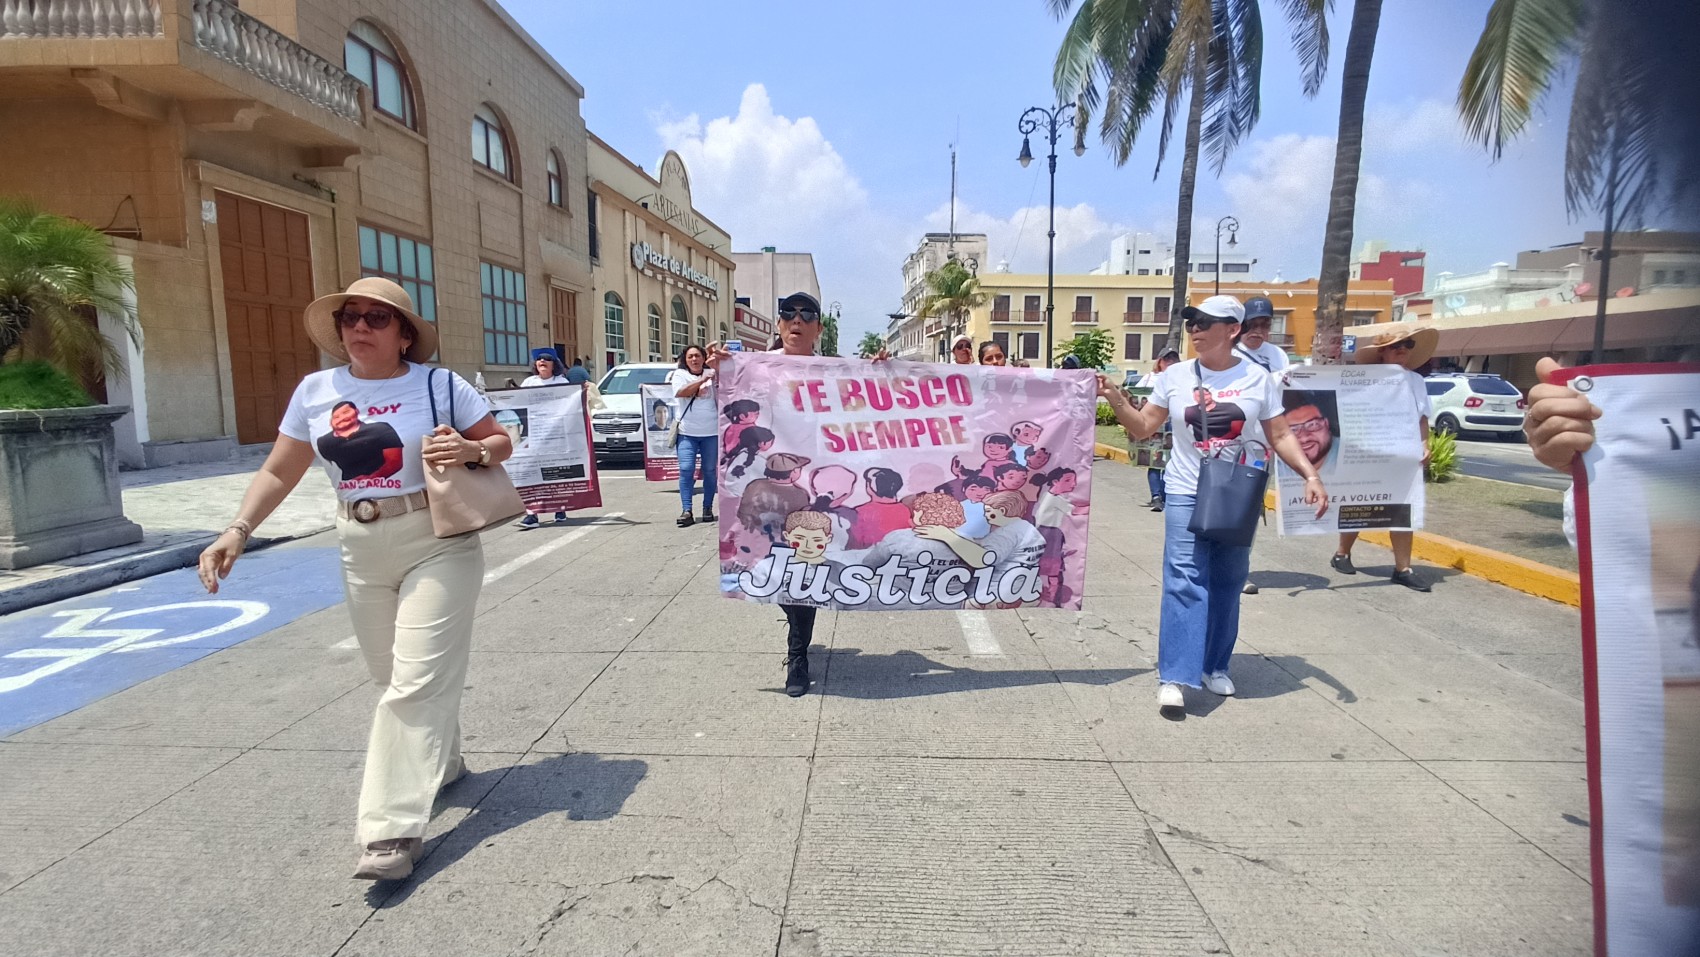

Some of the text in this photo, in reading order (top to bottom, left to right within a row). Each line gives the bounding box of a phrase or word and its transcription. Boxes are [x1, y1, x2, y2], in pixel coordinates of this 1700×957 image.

[642, 240, 669, 271] Plaza
[670, 255, 681, 275] de
[787, 373, 974, 412] TE BUSCO
[1217, 389, 1241, 398] SOY
[367, 403, 402, 416] SOY
[820, 415, 970, 453] SIEMPRE
[358, 479, 402, 489] CARLOS
[1350, 494, 1392, 502] VOLVER!
[738, 545, 1042, 606] Justicia
